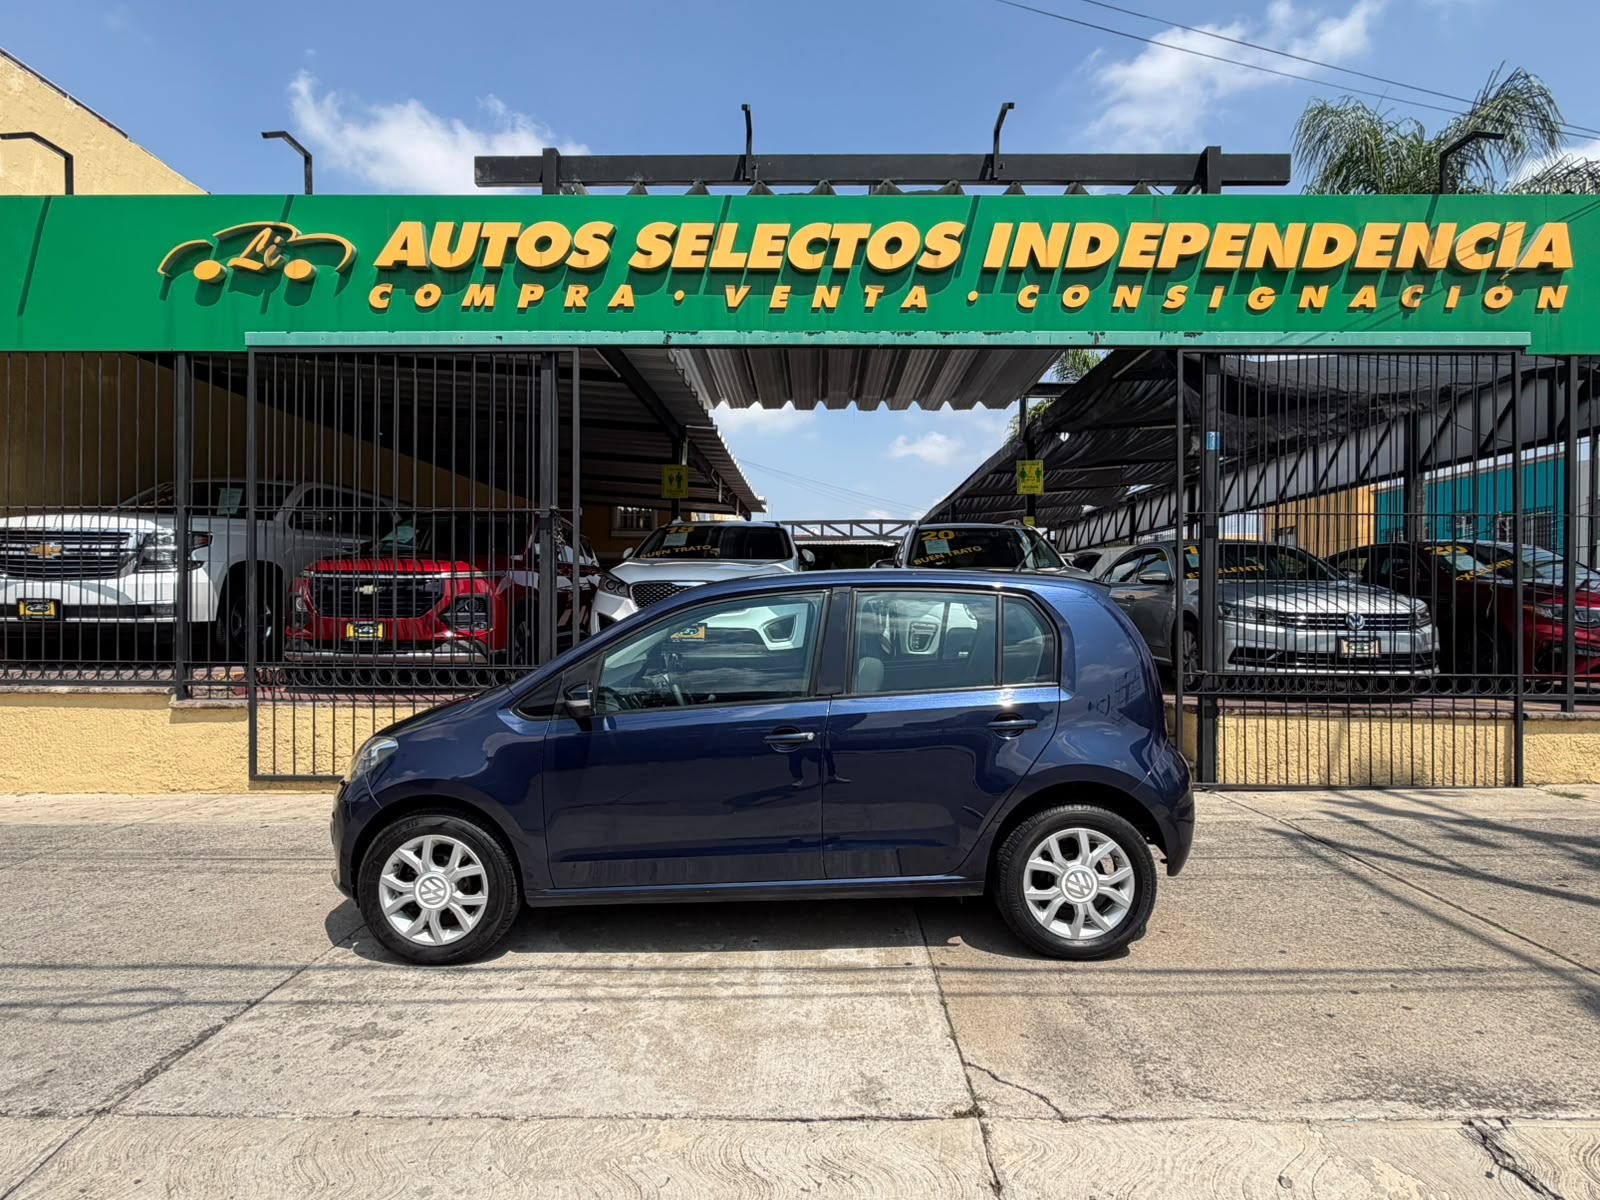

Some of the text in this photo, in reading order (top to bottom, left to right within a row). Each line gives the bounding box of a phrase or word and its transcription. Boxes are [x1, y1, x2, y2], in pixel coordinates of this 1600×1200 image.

[373, 221, 1574, 271] AUTOS SELECTOS INDEPENDENCIA
[368, 272, 1569, 310] COMPRA VENTA CONSIGNACIÓN
[920, 530, 956, 541] 20
[672, 544, 712, 553] TRATO
[913, 545, 982, 565] BUEN TRATO
